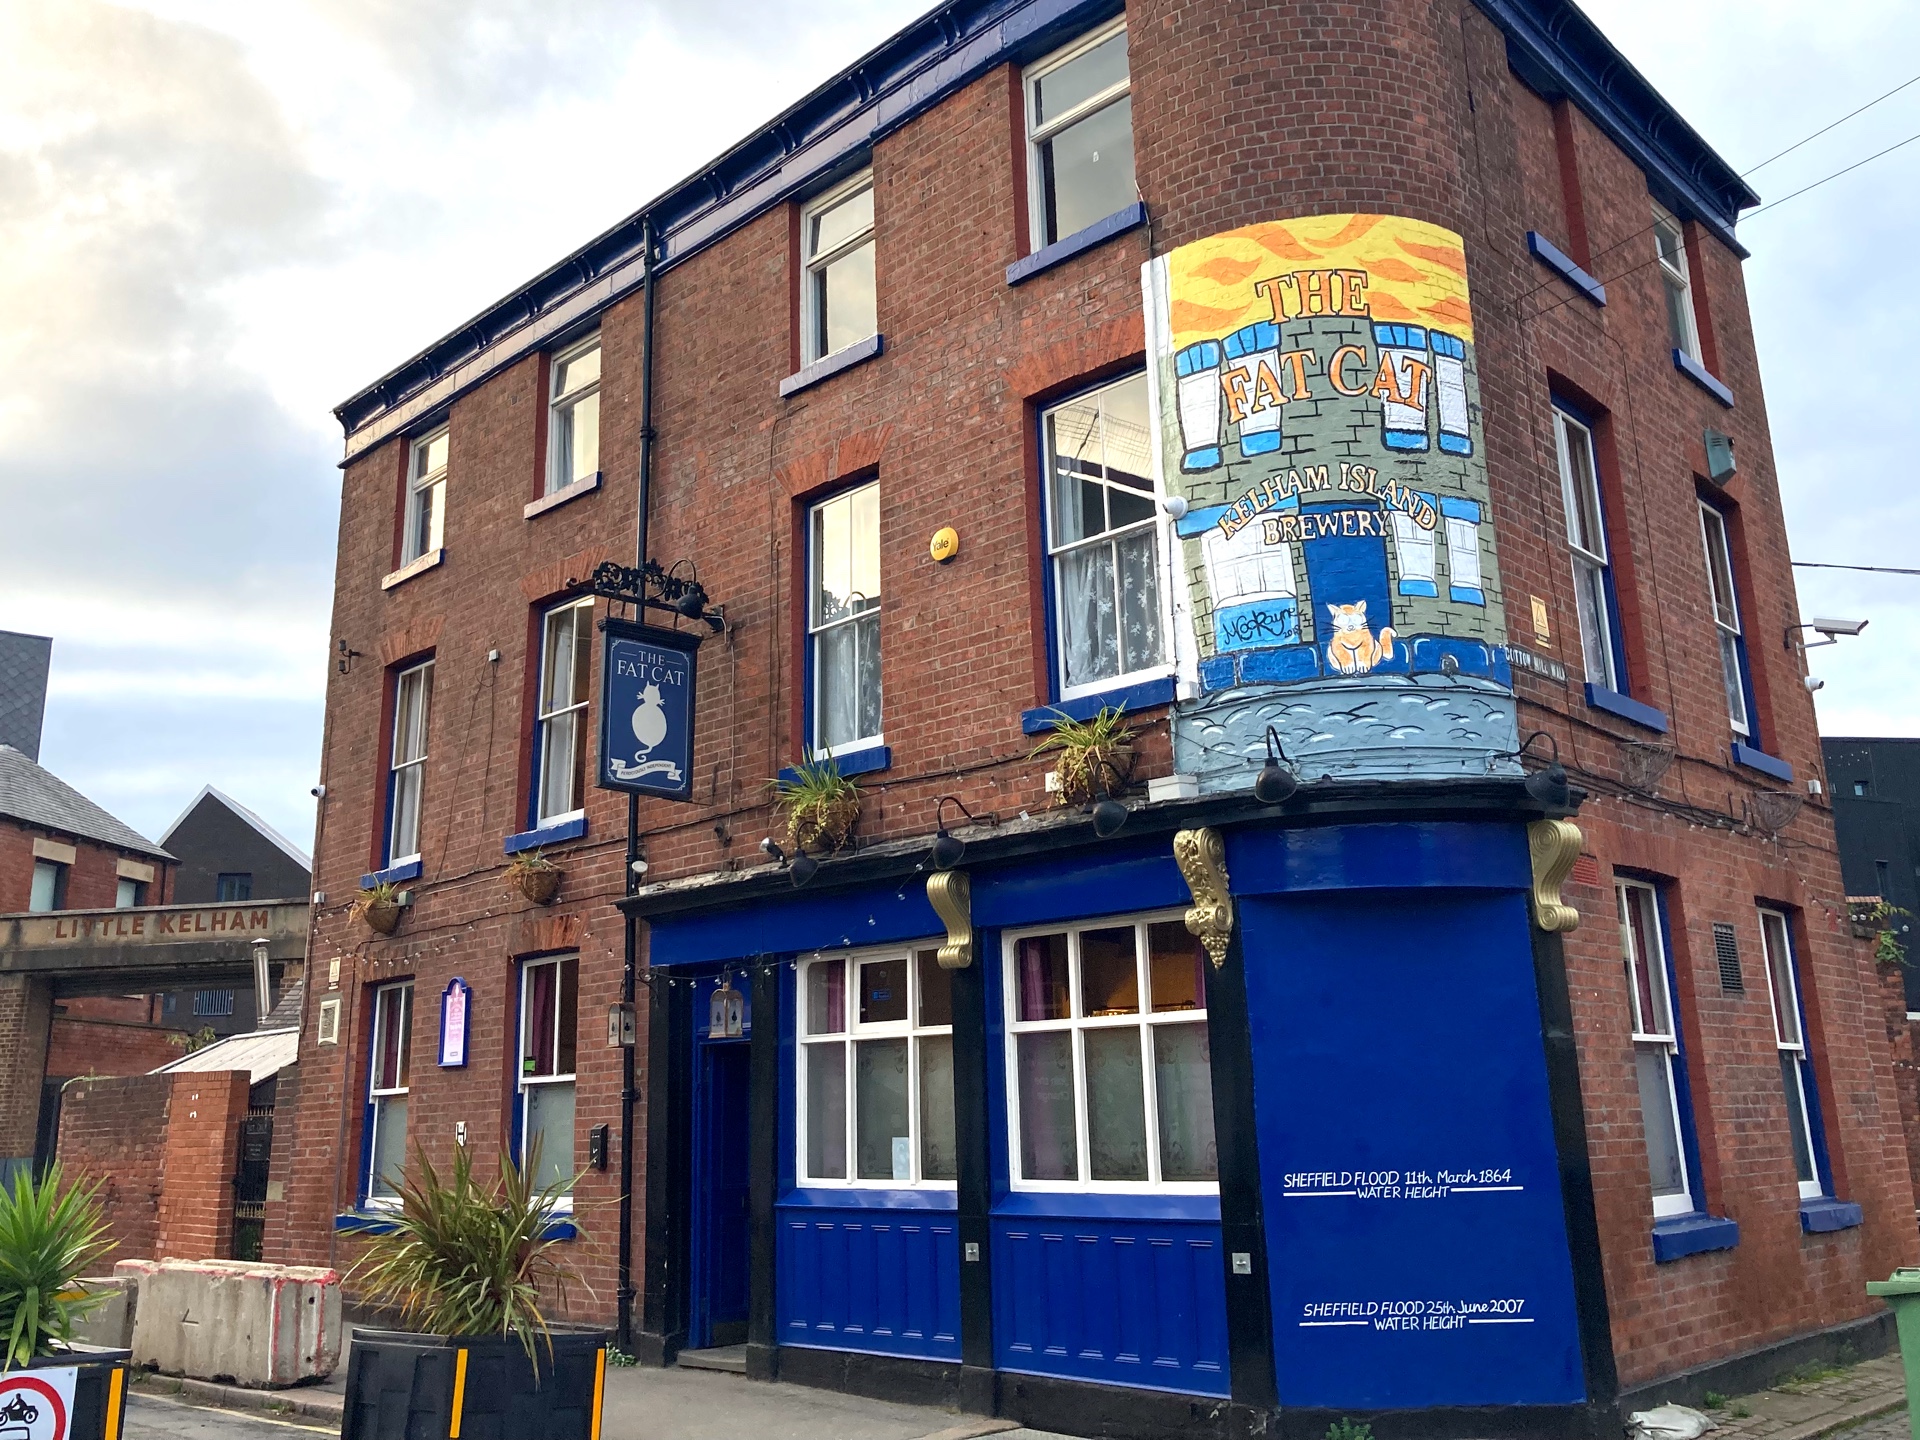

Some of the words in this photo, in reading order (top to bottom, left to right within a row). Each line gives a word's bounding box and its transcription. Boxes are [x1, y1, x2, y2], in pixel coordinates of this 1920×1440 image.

[1255, 269, 1370, 324] THE
[1219, 349, 1317, 425] FAT
[1327, 345, 1433, 412] CAT
[1217, 464, 1331, 541] KELHAM
[1338, 462, 1438, 531] ISLAND
[1263, 510, 1390, 545] BREWERY
[932, 538, 949, 552] Yale
[638, 650, 666, 667] THE
[1504, 645, 1531, 667] COTTON
[616, 658, 649, 679] FAT
[651, 666, 685, 686] CAT
[55, 916, 146, 939] LITTLE
[159, 910, 269, 934] KELHAM
[1283, 1171, 1352, 1188] SHEFFIELD
[1354, 1170, 1399, 1186] FLOOD
[1437, 1169, 1478, 1184] March
[1478, 1168, 1512, 1183] 1864
[1356, 1186, 1401, 1199] WATER
[1404, 1185, 1450, 1199] HEIGHT
[1303, 1302, 1379, 1317] SHEFFIELD
[1380, 1301, 1425, 1316] FLOOD
[1456, 1300, 1489, 1314] June
[1489, 1299, 1525, 1314] 2007
[1374, 1316, 1420, 1331] WATER
[1422, 1315, 1467, 1331] HEIGHT
